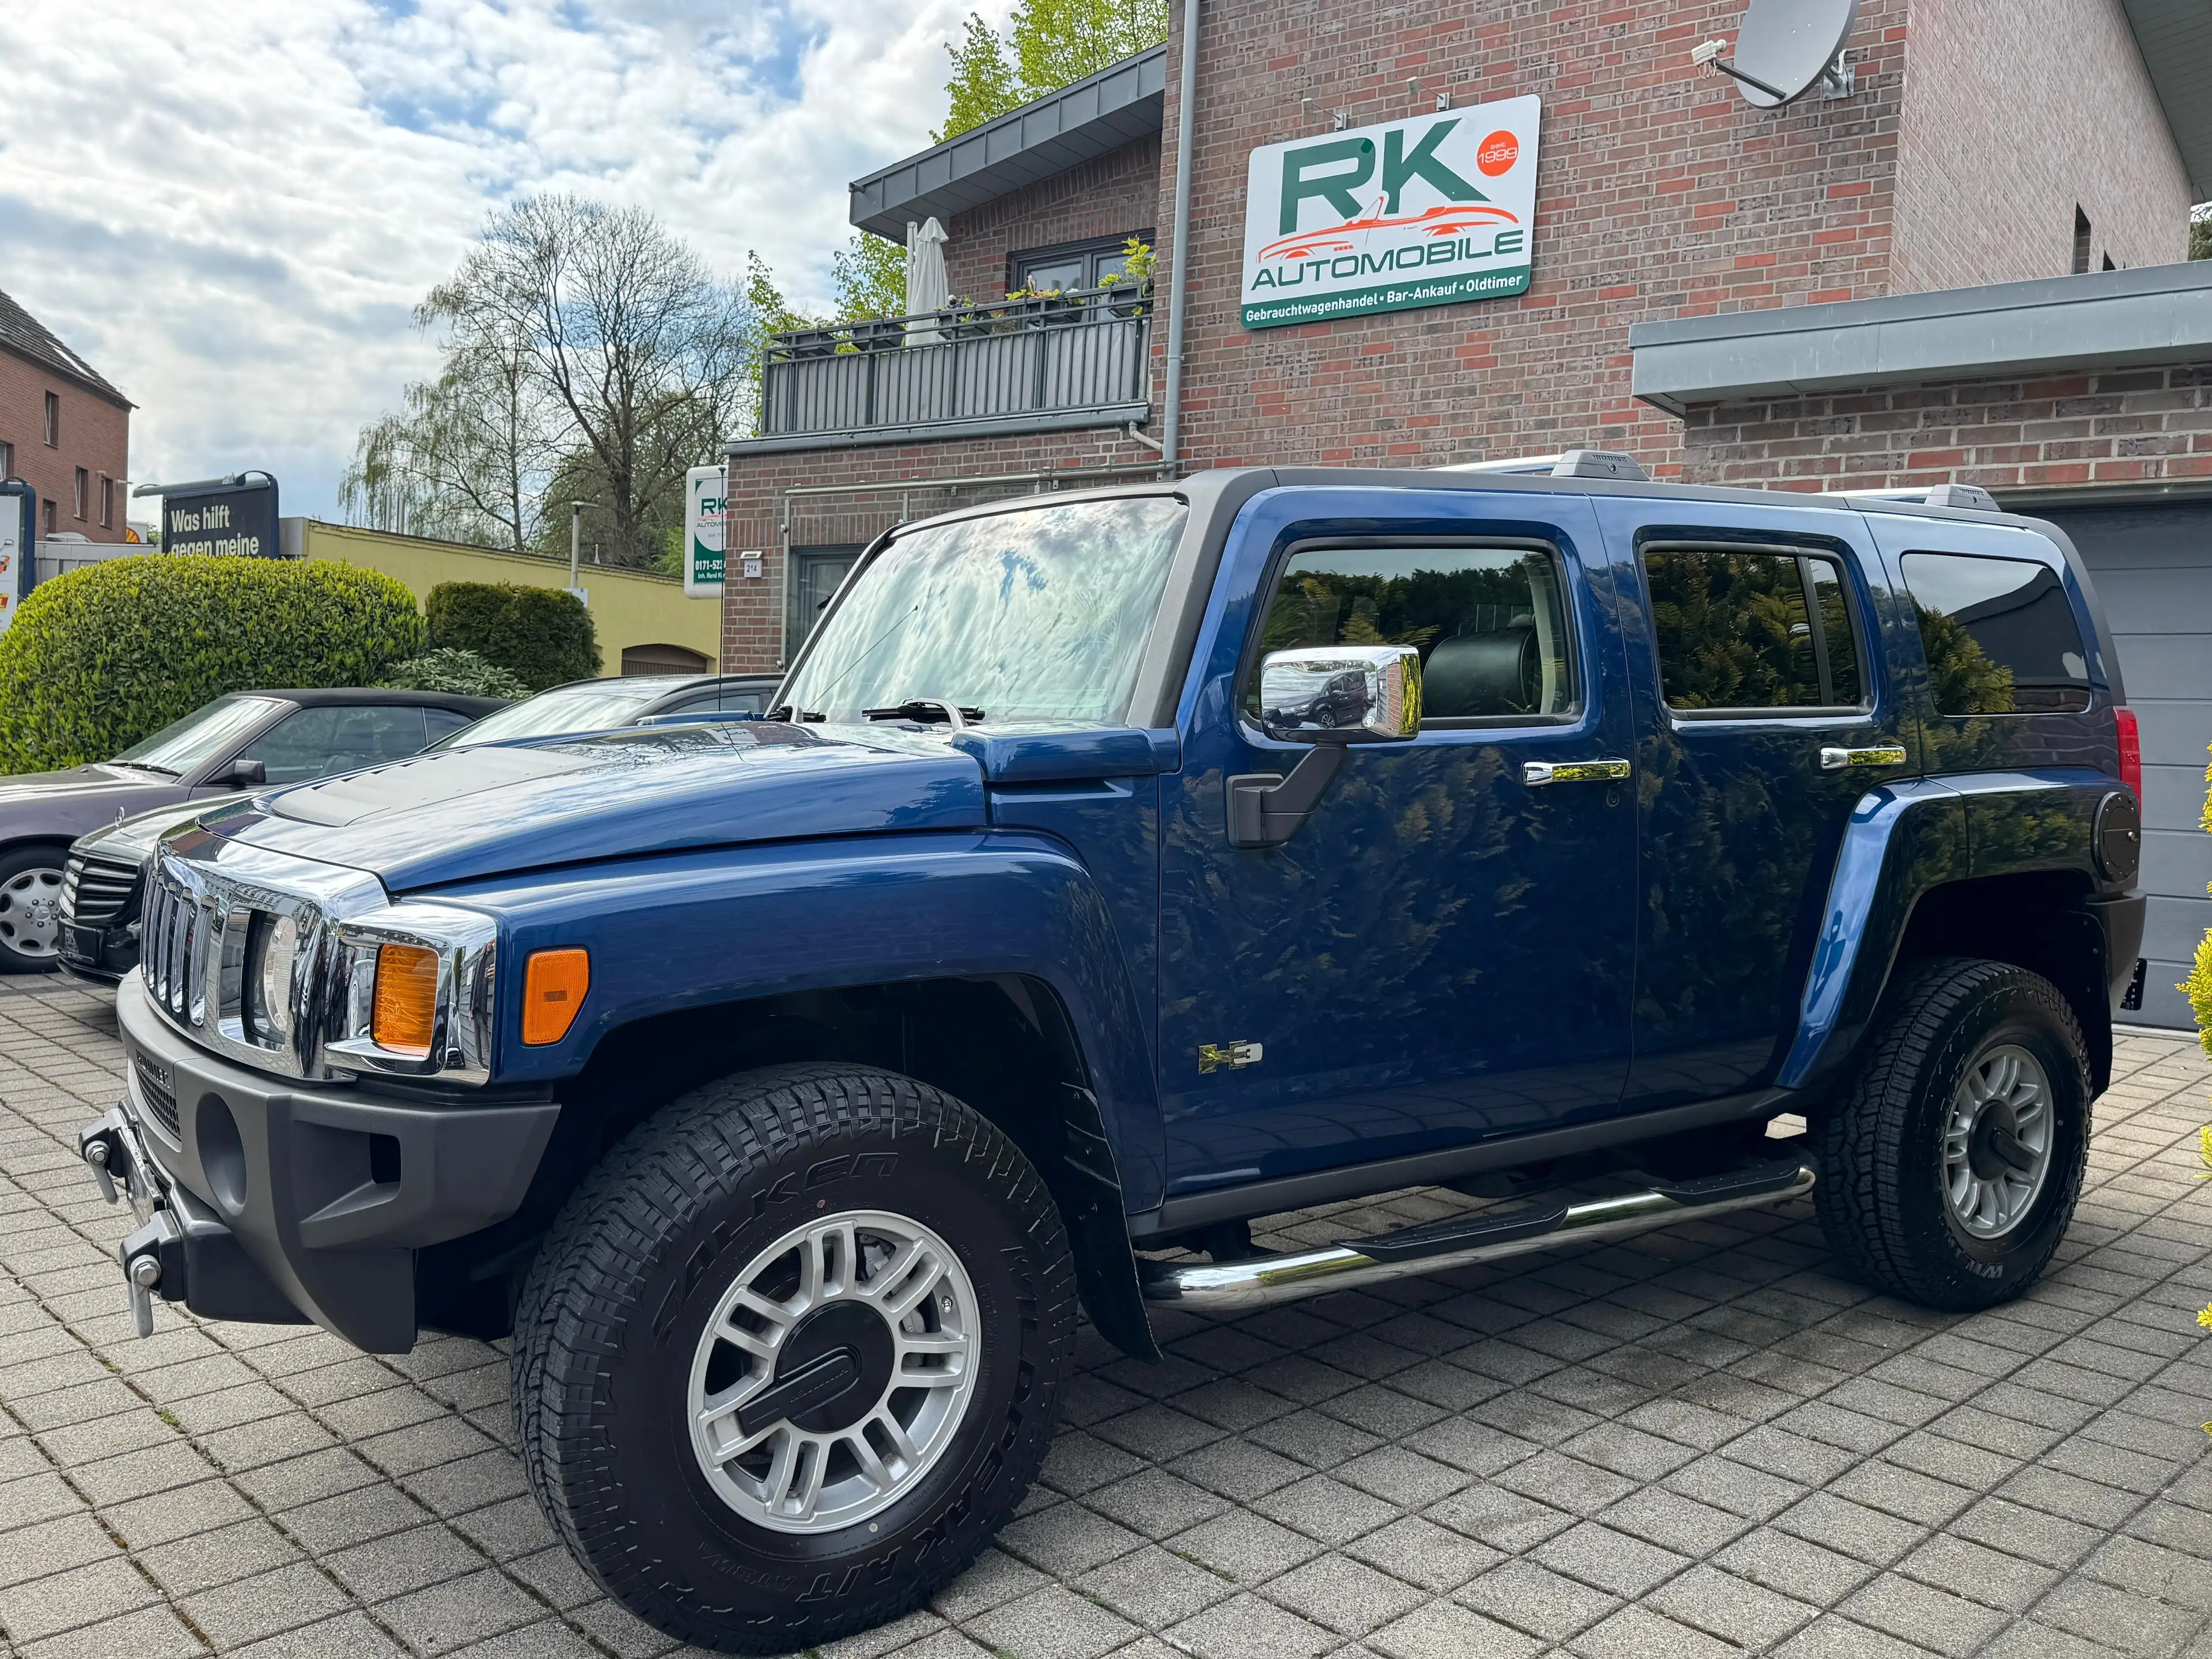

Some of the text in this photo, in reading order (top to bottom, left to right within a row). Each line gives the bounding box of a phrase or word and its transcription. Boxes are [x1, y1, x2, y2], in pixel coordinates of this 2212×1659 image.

[1478, 147, 1518, 164] 1999
[1279, 118, 1491, 236] RK
[1251, 229, 1524, 291] AUTOMOBILE
[1245, 274, 1524, 322] Gebrauchtwagenhandel Bar-Ankauf Oldtimer
[171, 505, 230, 533] Was hilft
[215, 532, 259, 557] meine
[747, 565, 757, 573] 214
